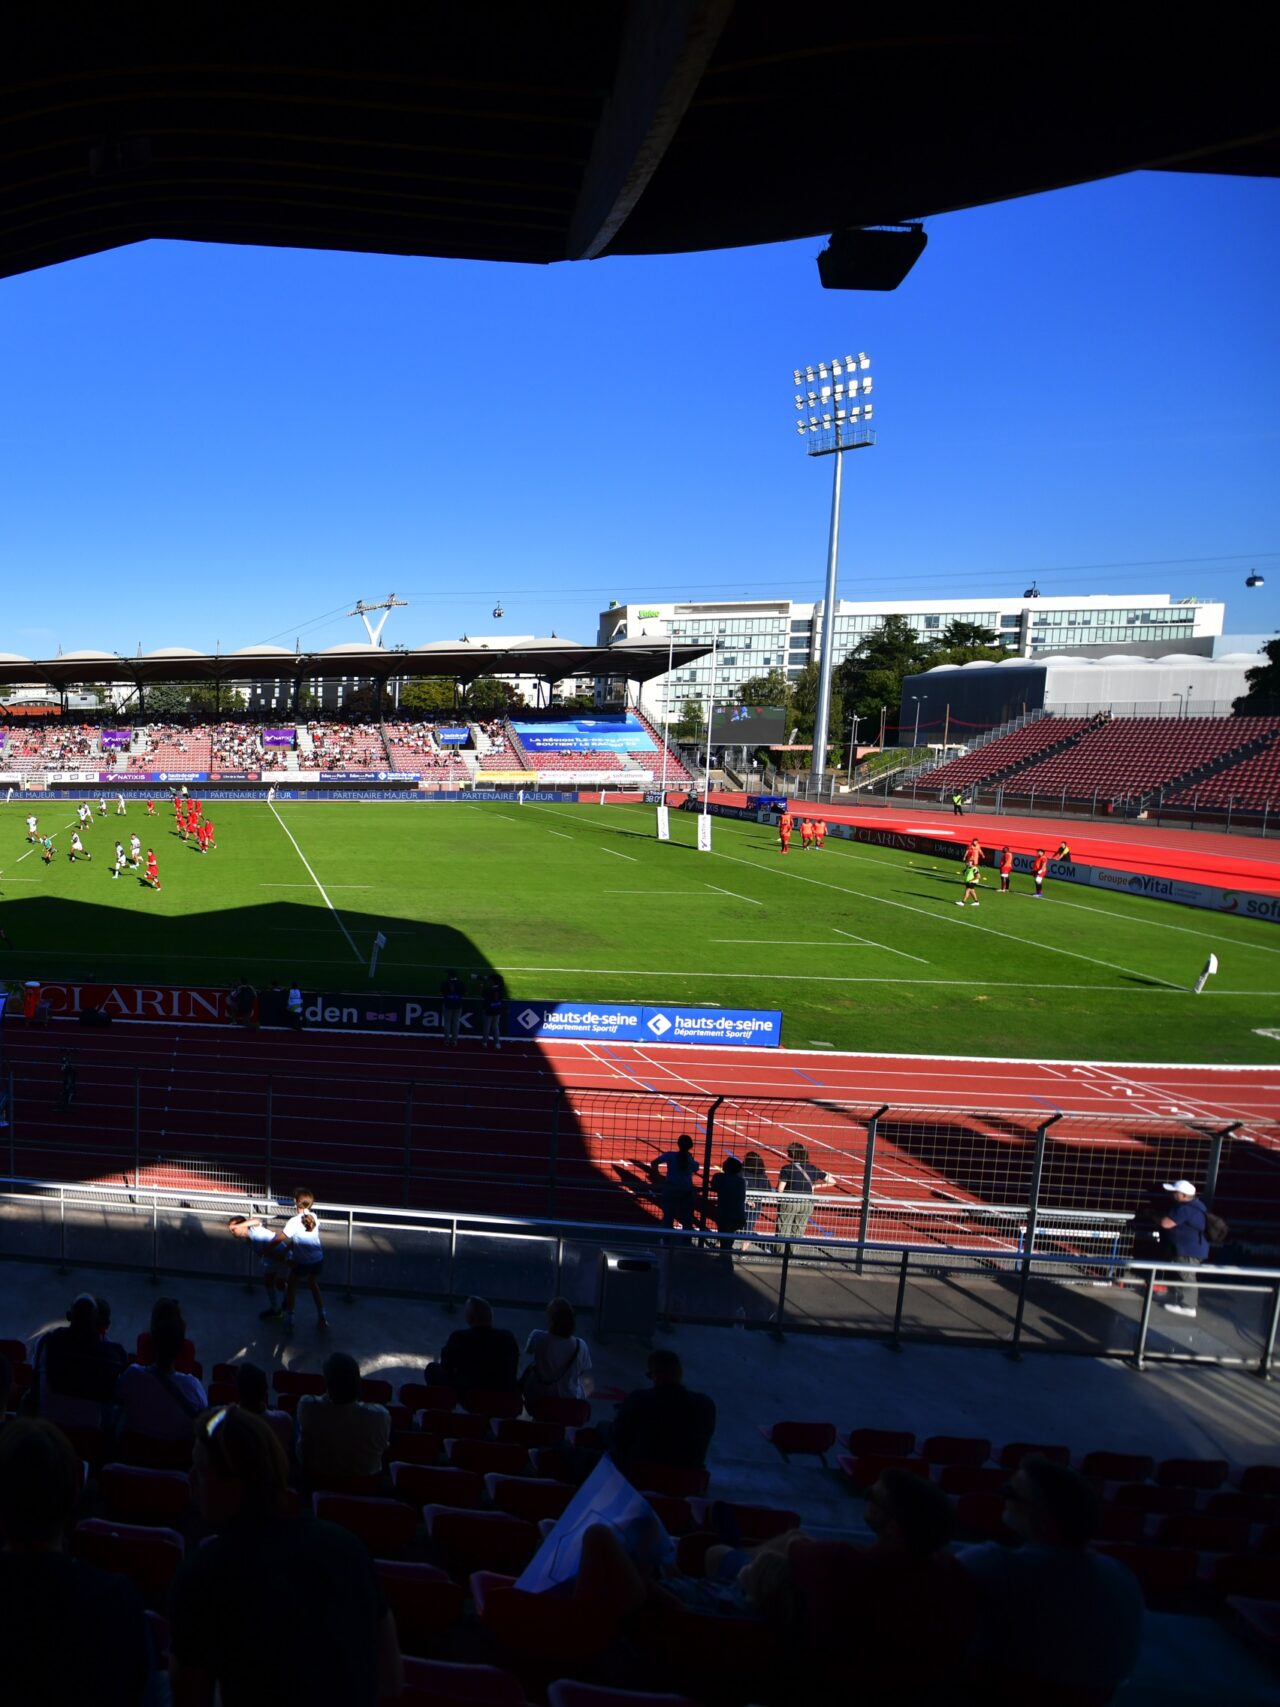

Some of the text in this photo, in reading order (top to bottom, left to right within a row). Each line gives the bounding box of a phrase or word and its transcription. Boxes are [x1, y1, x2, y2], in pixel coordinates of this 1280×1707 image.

[462, 792, 517, 800] PARTENAIRE
[859, 829, 916, 849] CLARINS
[1098, 871, 1128, 886] Groupe
[1142, 876, 1173, 895] Vital
[39, 984, 232, 1019] CLARIN
[304, 996, 358, 1024] den
[543, 1010, 638, 1027] hauts-de-seine
[675, 1015, 773, 1032] hauts-de-seine
[542, 1023, 618, 1034] Département Sportif
[674, 1028, 753, 1039] Département Sportif
[1111, 1085, 1145, 1098] 2
